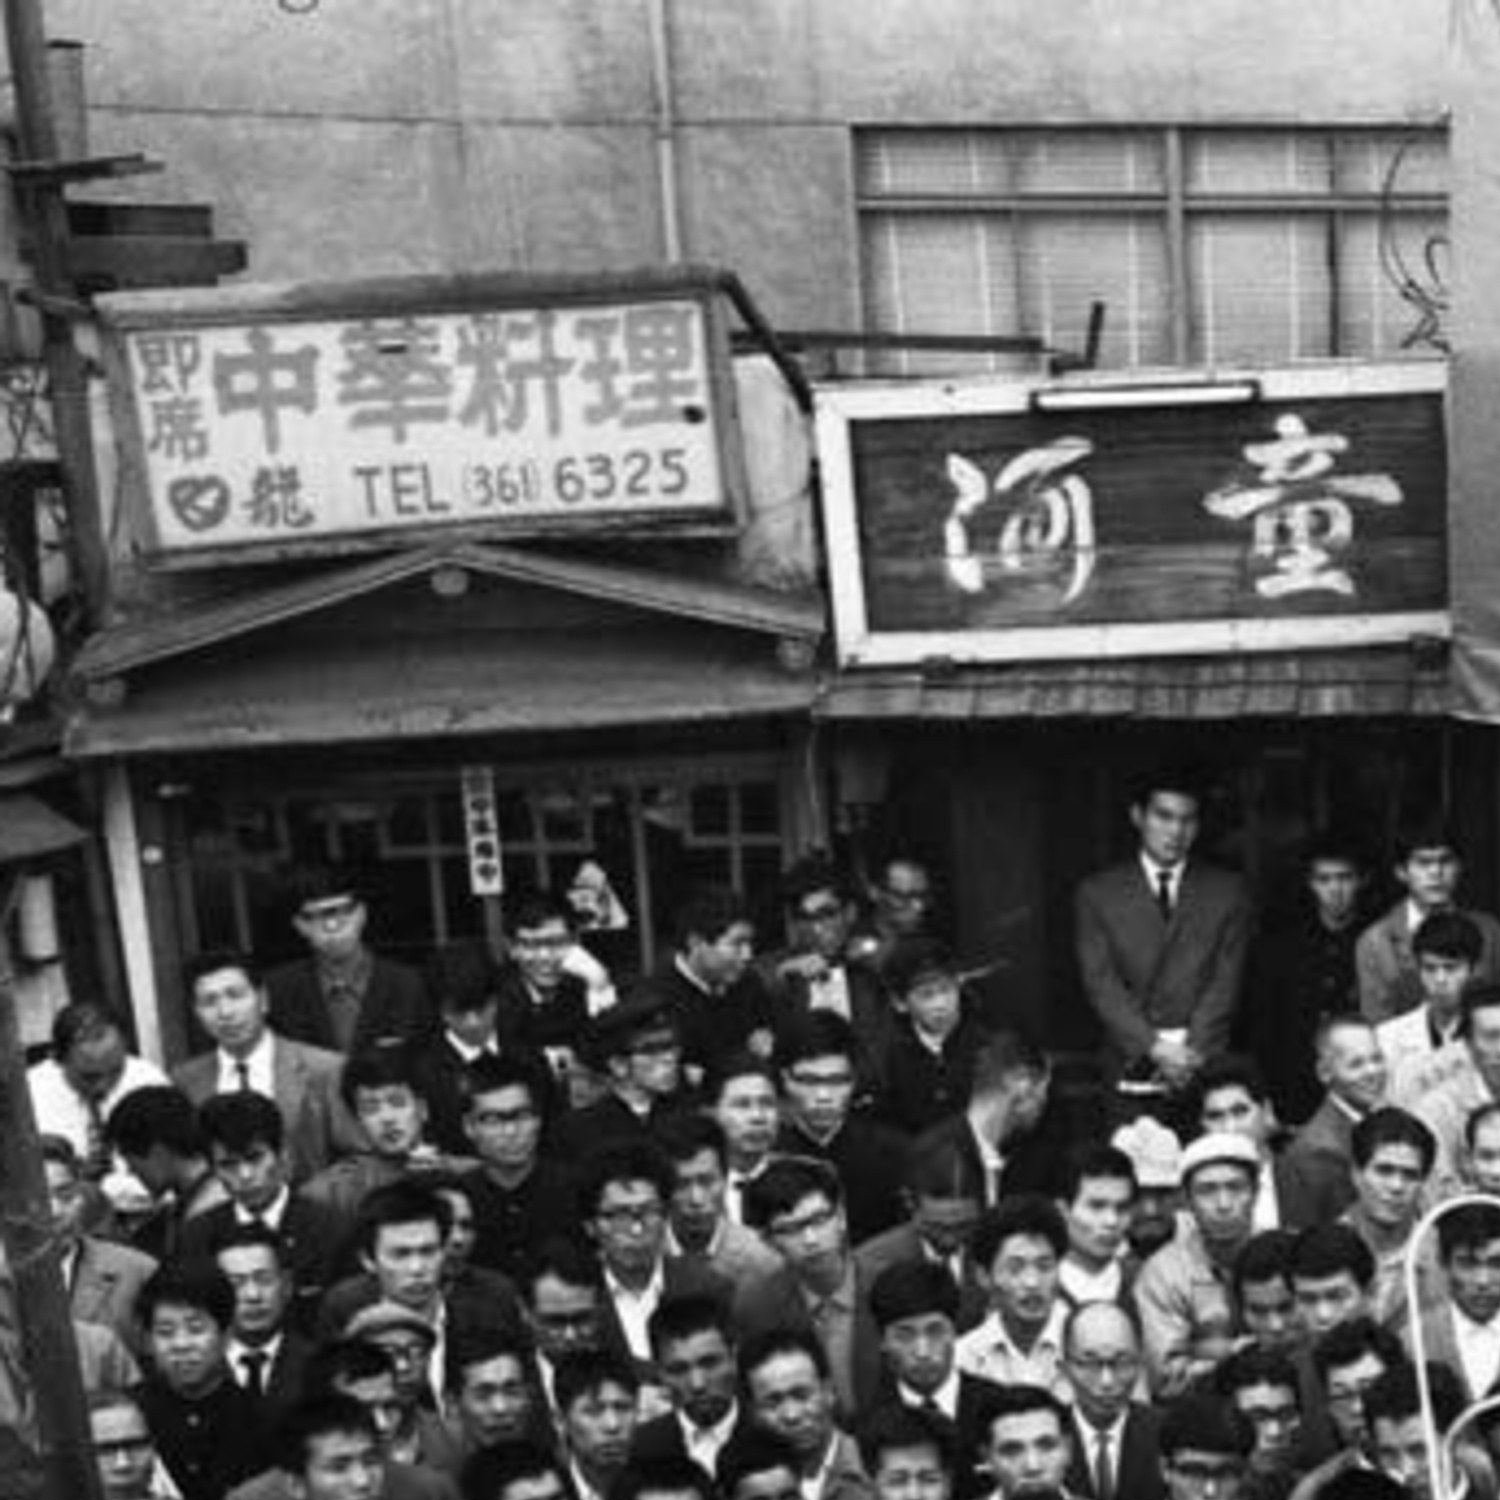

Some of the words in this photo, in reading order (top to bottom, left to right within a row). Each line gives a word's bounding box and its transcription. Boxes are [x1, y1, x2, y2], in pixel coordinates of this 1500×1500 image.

[212, 307, 702, 452] 中華料理
[354, 462, 450, 517] TEL
[555, 449, 690, 503] 6325
[944, 413, 1404, 605] 河童
